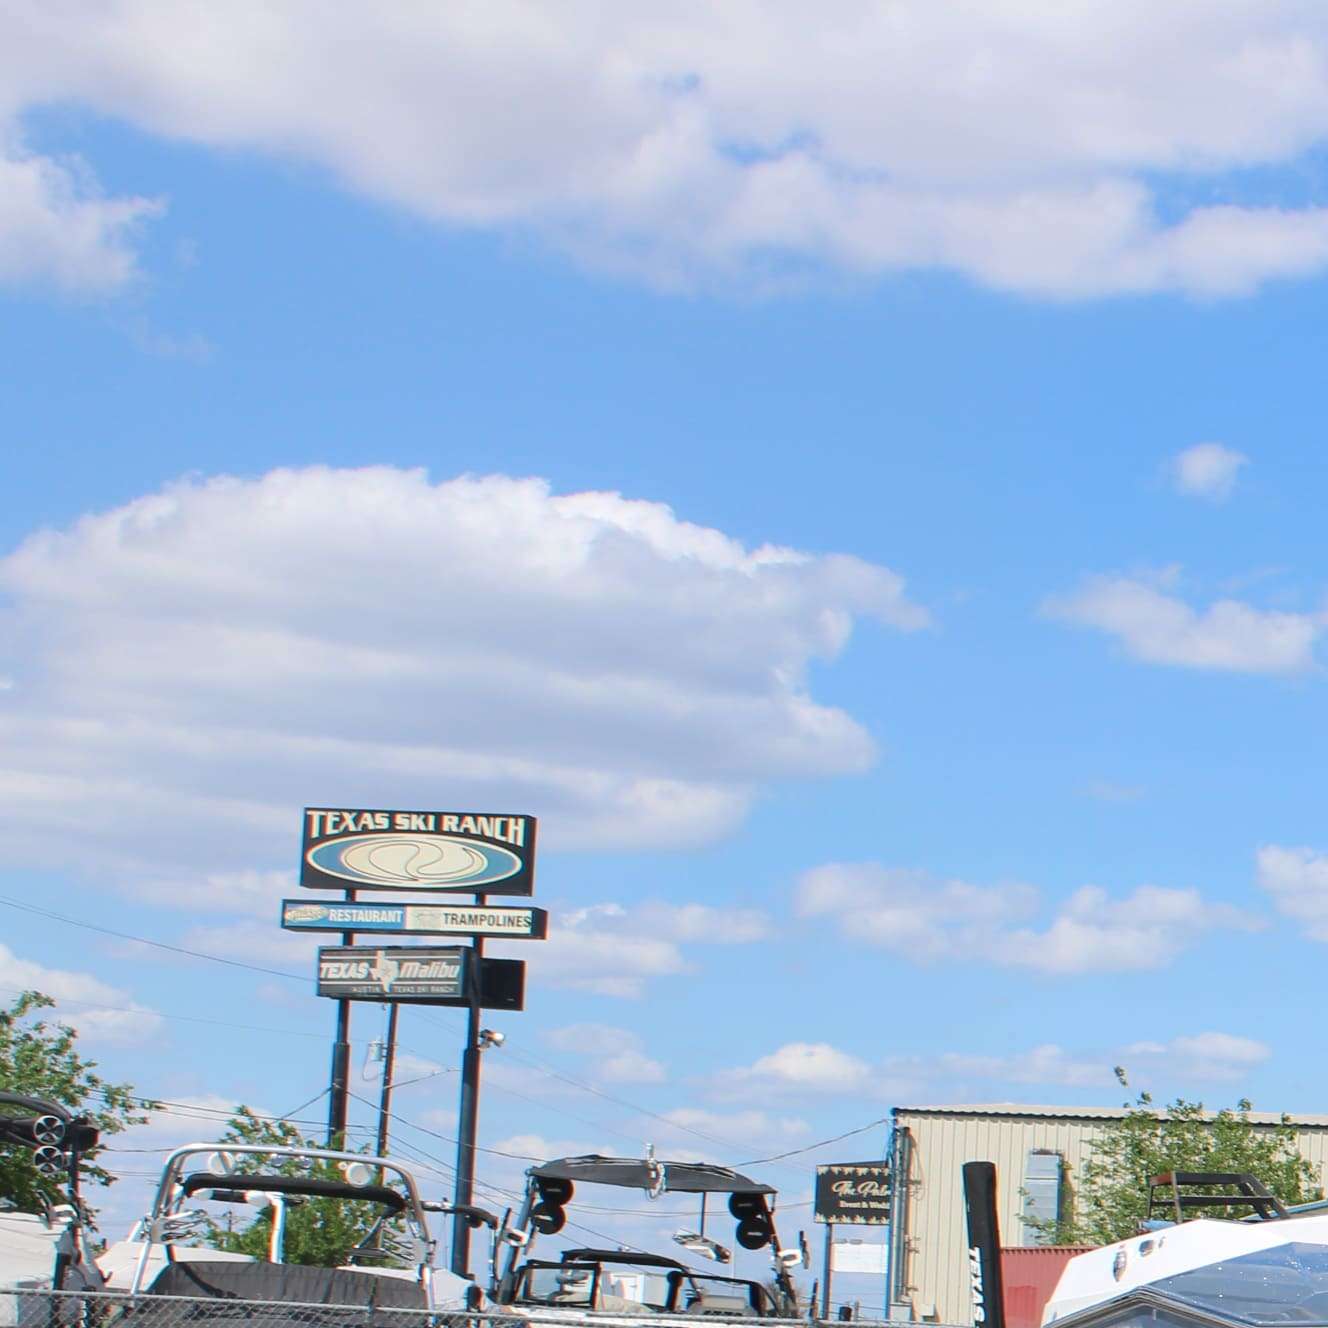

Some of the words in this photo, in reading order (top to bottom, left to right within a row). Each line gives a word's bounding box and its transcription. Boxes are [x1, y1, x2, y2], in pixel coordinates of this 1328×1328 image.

[307, 809, 390, 838] TEXAS
[394, 813, 436, 832] SKI
[440, 815, 525, 848] RANCH
[328, 908, 404, 925] RESTAURANT
[443, 911, 533, 929] TRAMPOLINES
[319, 961, 370, 979] TEXAS
[399, 961, 461, 979] Malibu
[968, 1246, 986, 1323] TEXAS
